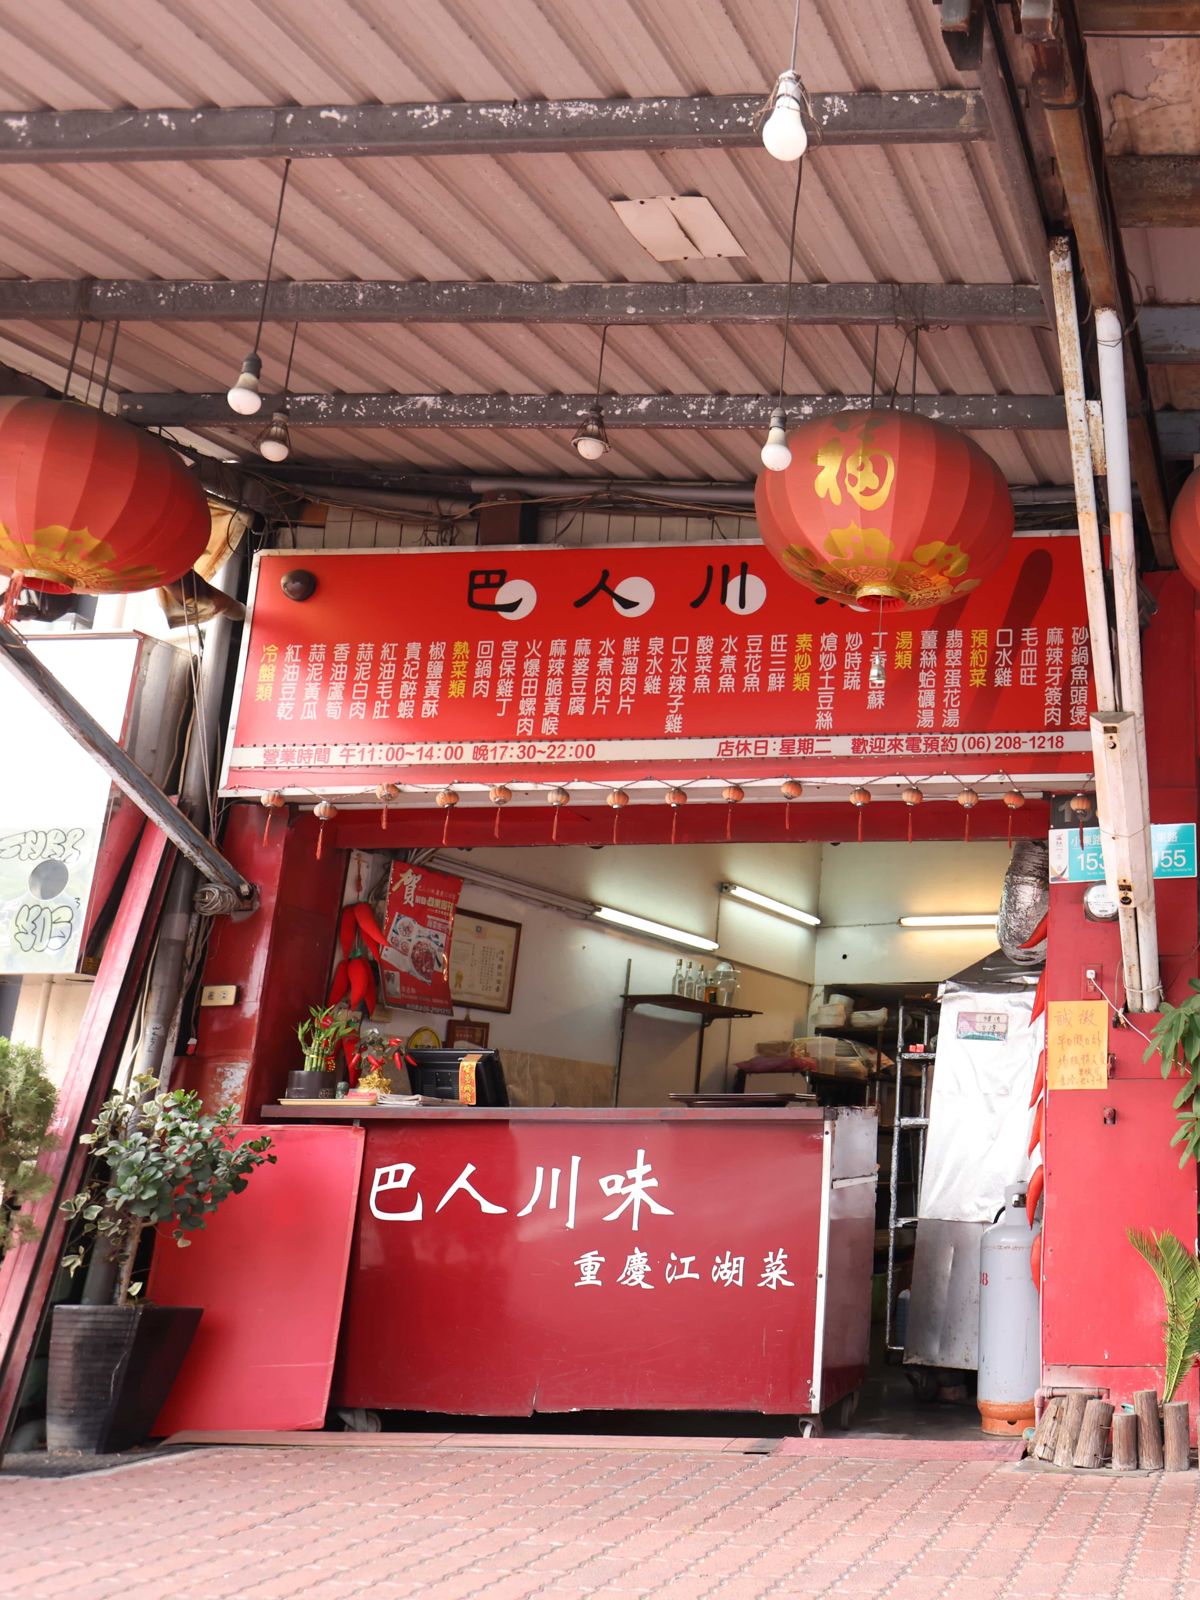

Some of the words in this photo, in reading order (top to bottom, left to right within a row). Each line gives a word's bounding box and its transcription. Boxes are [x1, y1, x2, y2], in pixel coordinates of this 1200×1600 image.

[255, 644, 278, 701] 冷盤類
[276, 644, 302, 720] 紅油豆乾
[300, 643, 326, 720] 蒜泥黃瓜
[326, 643, 350, 720] 香油蘆筍
[349, 643, 374, 719] 蒜泥白肉
[372, 642, 398, 719] 紅油毛肚
[396, 642, 422, 719] 貴妃醉蝦
[448, 640, 470, 699] 熱菜類
[472, 640, 494, 698] 回鍋肉
[496, 640, 518, 716] 宮保雞丁
[516, 639, 542, 736] 火爆田螺肉
[541, 639, 567, 736] 麻辣脆黃喉
[567, 638, 592, 716] 麻婆豆腐
[592, 638, 615, 715] 水煮肉片
[617, 637, 640, 715] 鮮溜肉片
[643, 636, 664, 694] 泉水雞
[664, 636, 689, 734] 口水辣子雞
[693, 635, 714, 693] 酸菜魚
[718, 635, 738, 693] 水煮魚
[742, 635, 763, 693] 豆花魚
[767, 634, 788, 692] 旺三鮮
[792, 633, 813, 692] 素炒類
[843, 632, 863, 690] 炒時蔬
[894, 631, 913, 670] 湯類
[942, 629, 963, 728] 翡翠蛋花湯
[969, 629, 988, 688] 預約菜
[994, 628, 1013, 687] 口水雞
[1020, 627, 1039, 686] 毛血旺
[1069, 626, 1089, 726] 砂鍋魚頭煲
[369, 1149, 675, 1231] 巴人川味
[573, 1247, 795, 1290] 重慶江湖菜
